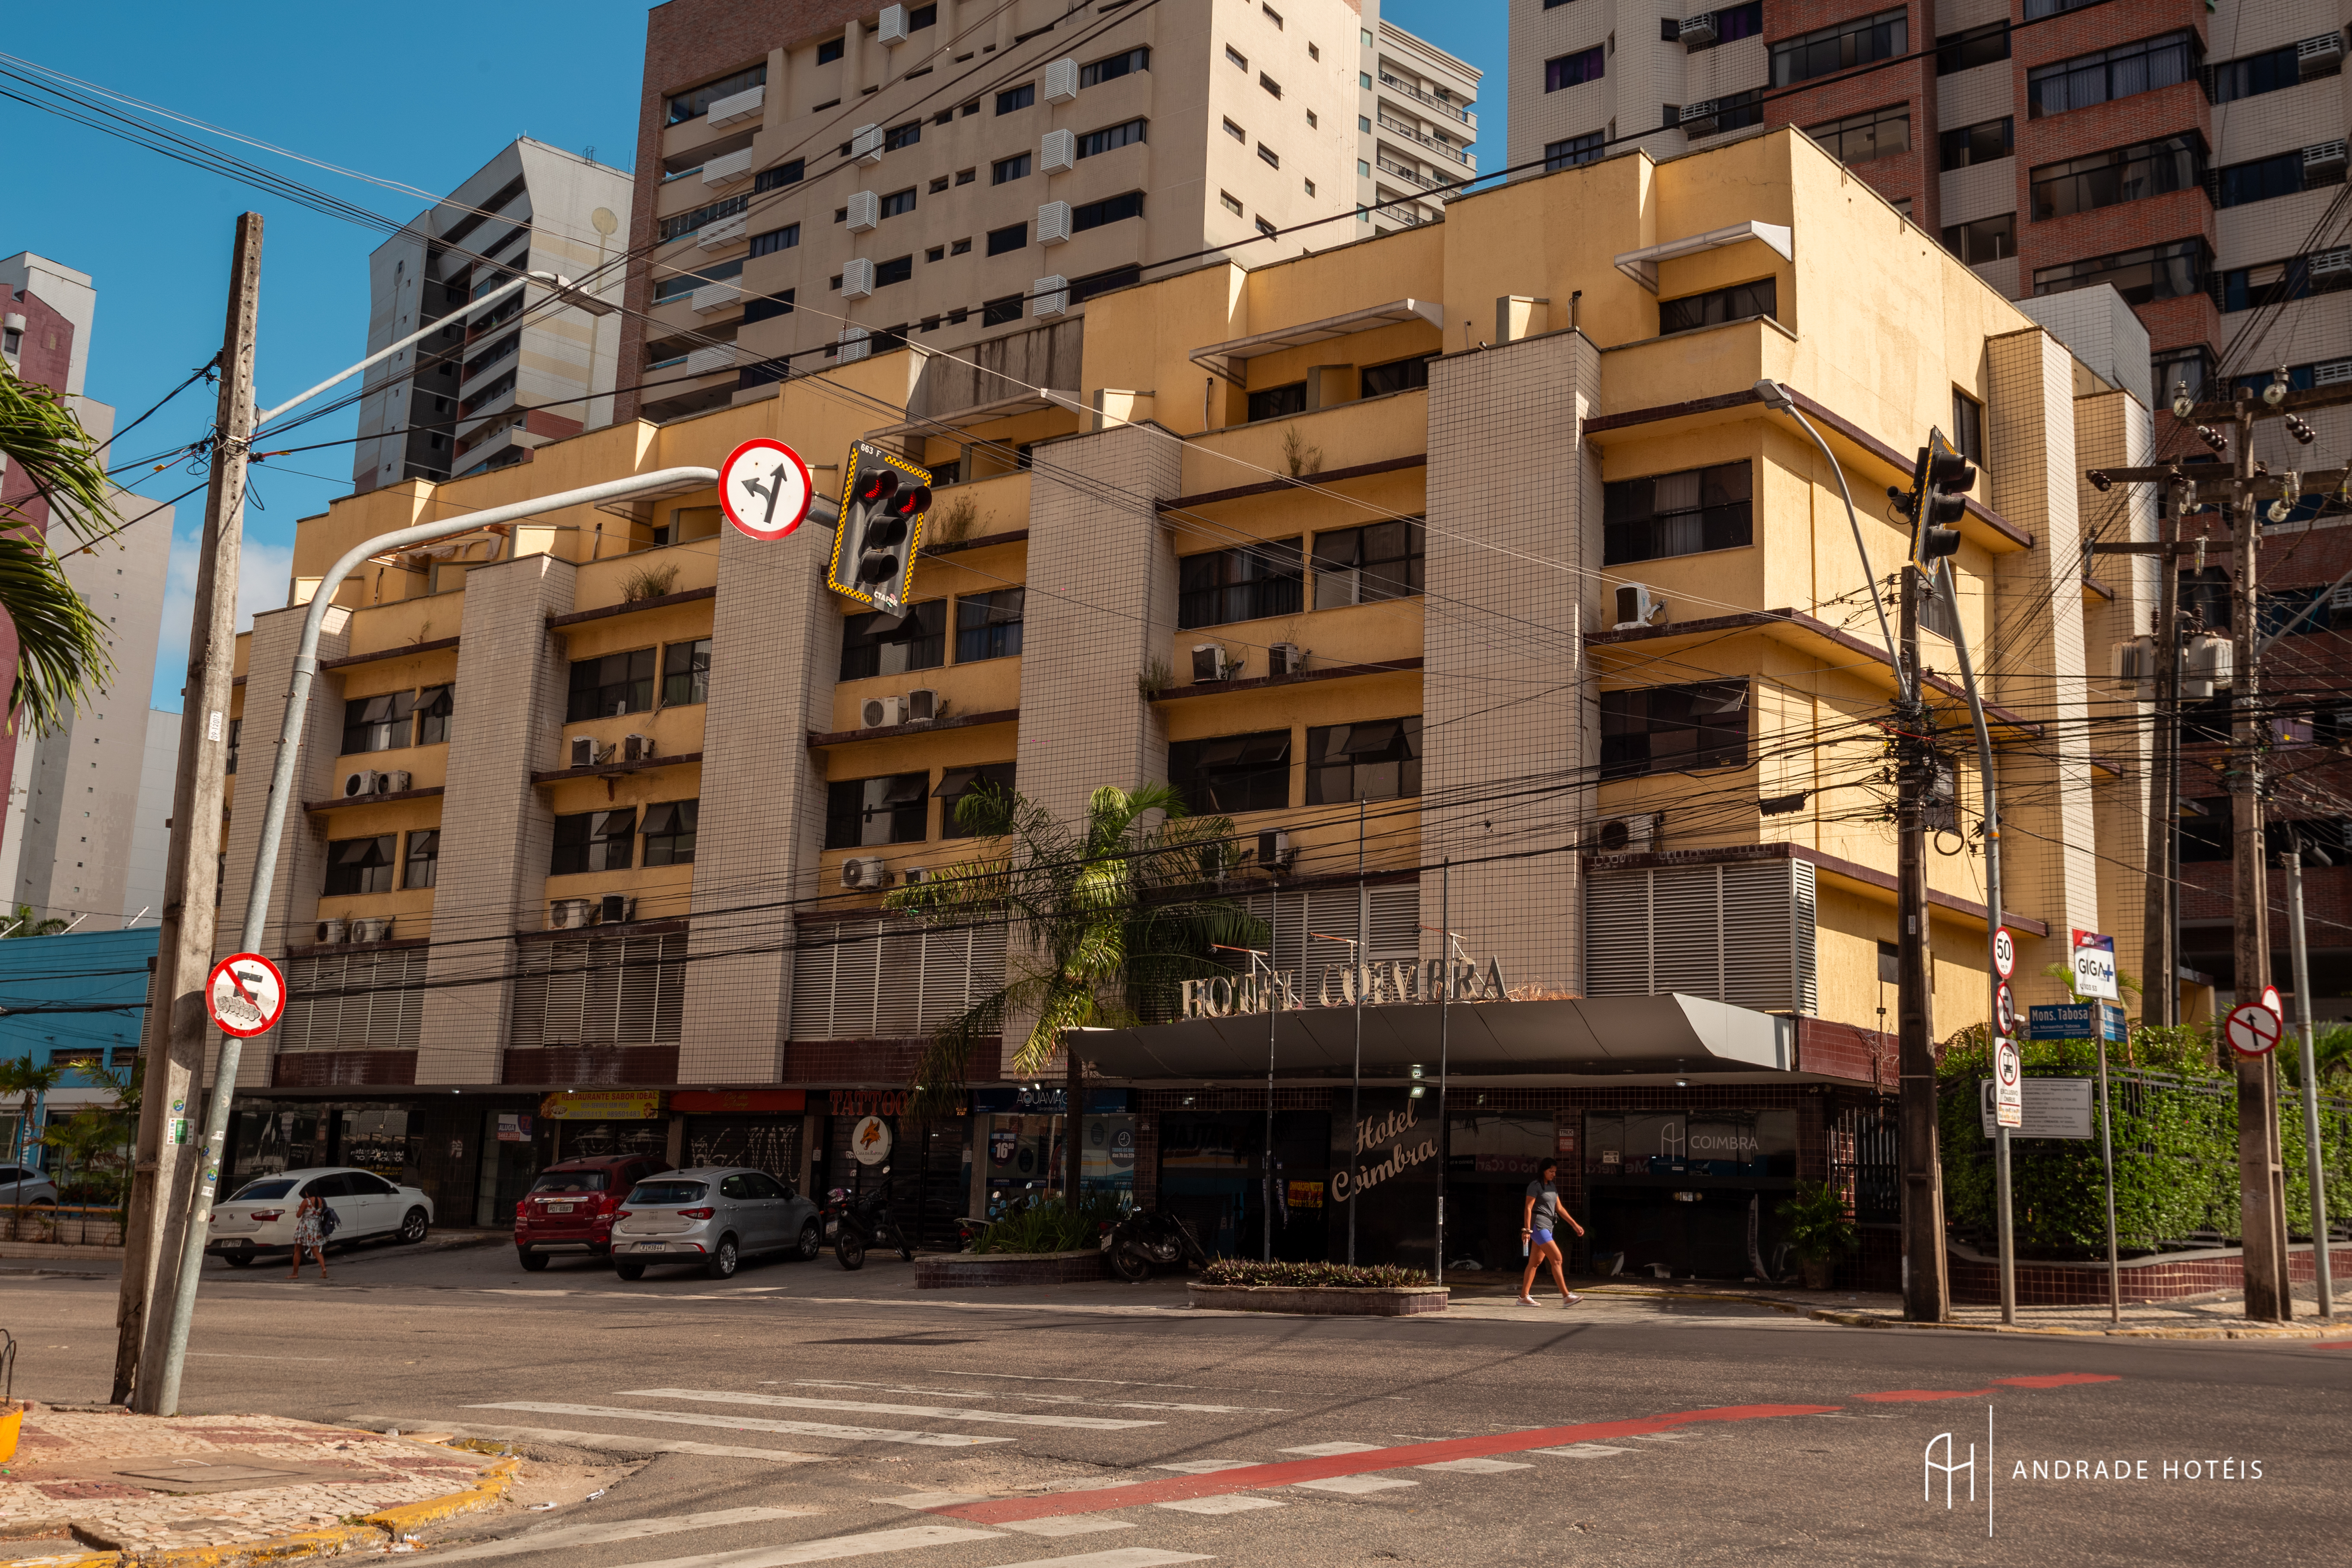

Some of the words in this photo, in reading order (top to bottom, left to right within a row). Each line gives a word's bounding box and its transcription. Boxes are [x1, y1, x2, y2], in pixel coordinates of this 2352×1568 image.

[860, 443, 873, 455] 663
[876, 449, 882, 458] F
[874, 590, 898, 607] CTAFOR
[211, 714, 220, 739] 09-12017
[1997, 938, 2011, 961] 50
[1179, 969, 1304, 1020] HOTEL
[1316, 954, 1509, 1007] COIMBRA
[2032, 1010, 2056, 1021] Mons.
[2058, 1007, 2088, 1020] Tabosa
[829, 1090, 908, 1116] TATTOO
[521, 1116, 532, 1129] FZ
[1355, 1098, 1418, 1156] Hotel
[995, 1142, 1014, 1158] 16,00
[1690, 1135, 1759, 1150] COIMBRA
[1332, 1138, 1438, 1202] Coimbra
